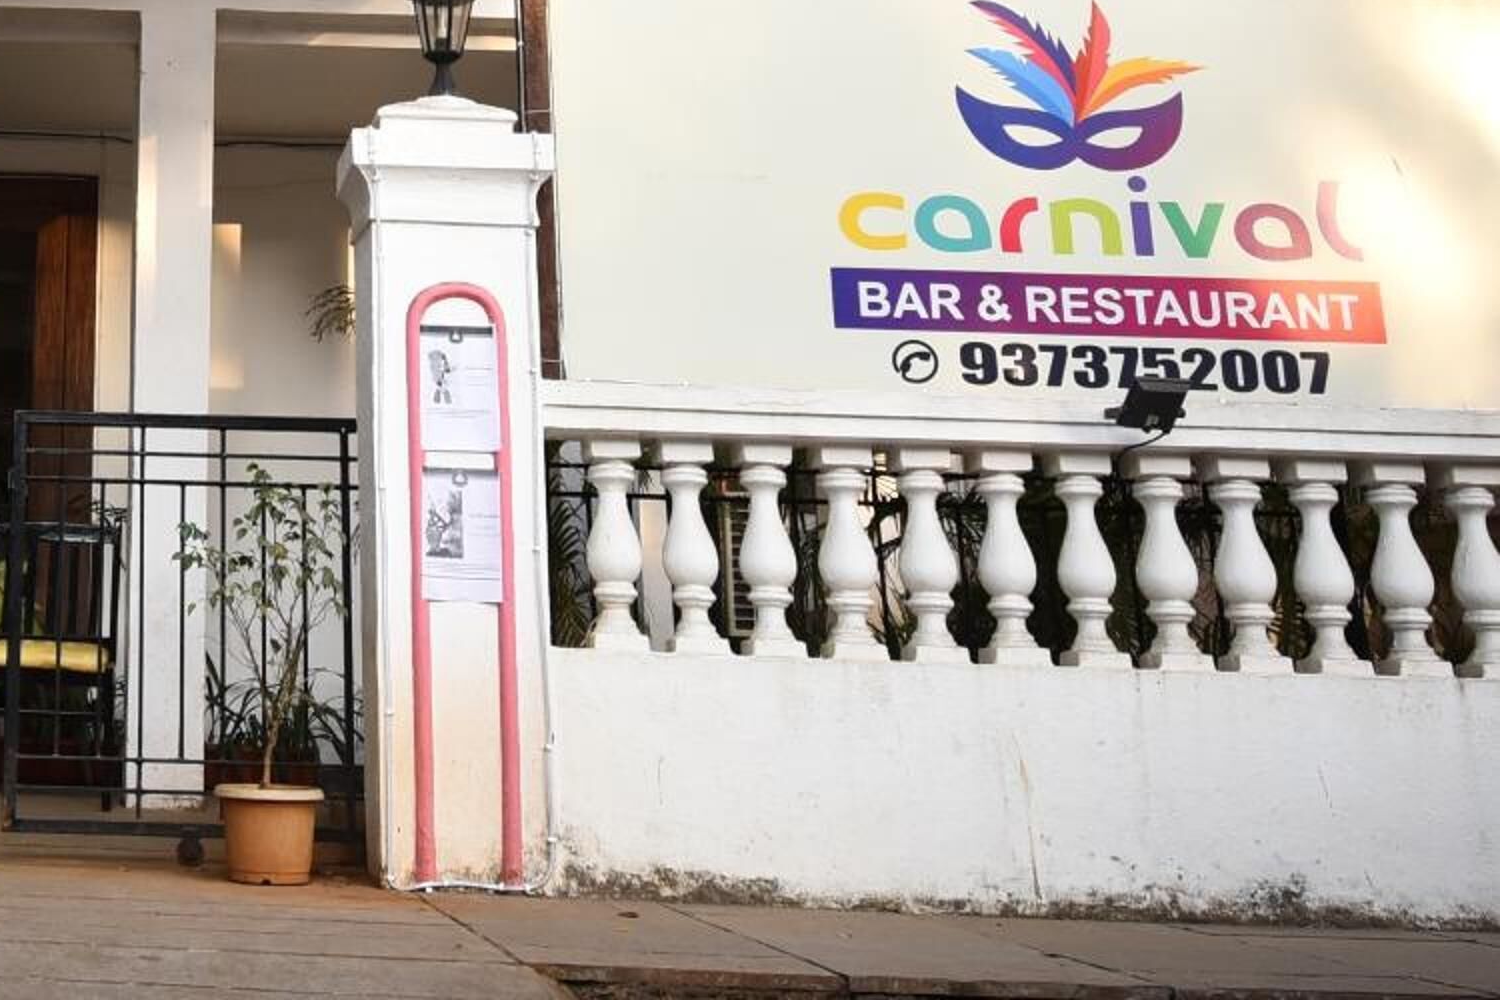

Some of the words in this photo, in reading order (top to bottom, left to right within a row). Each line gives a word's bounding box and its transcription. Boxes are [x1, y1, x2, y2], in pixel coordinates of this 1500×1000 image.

[838, 174, 1365, 263] carnival
[856, 280, 966, 321] BAR
[978, 285, 1012, 323] &
[1025, 286, 1360, 332] RESTAURANT
[959, 341, 1331, 395] 9373752007
